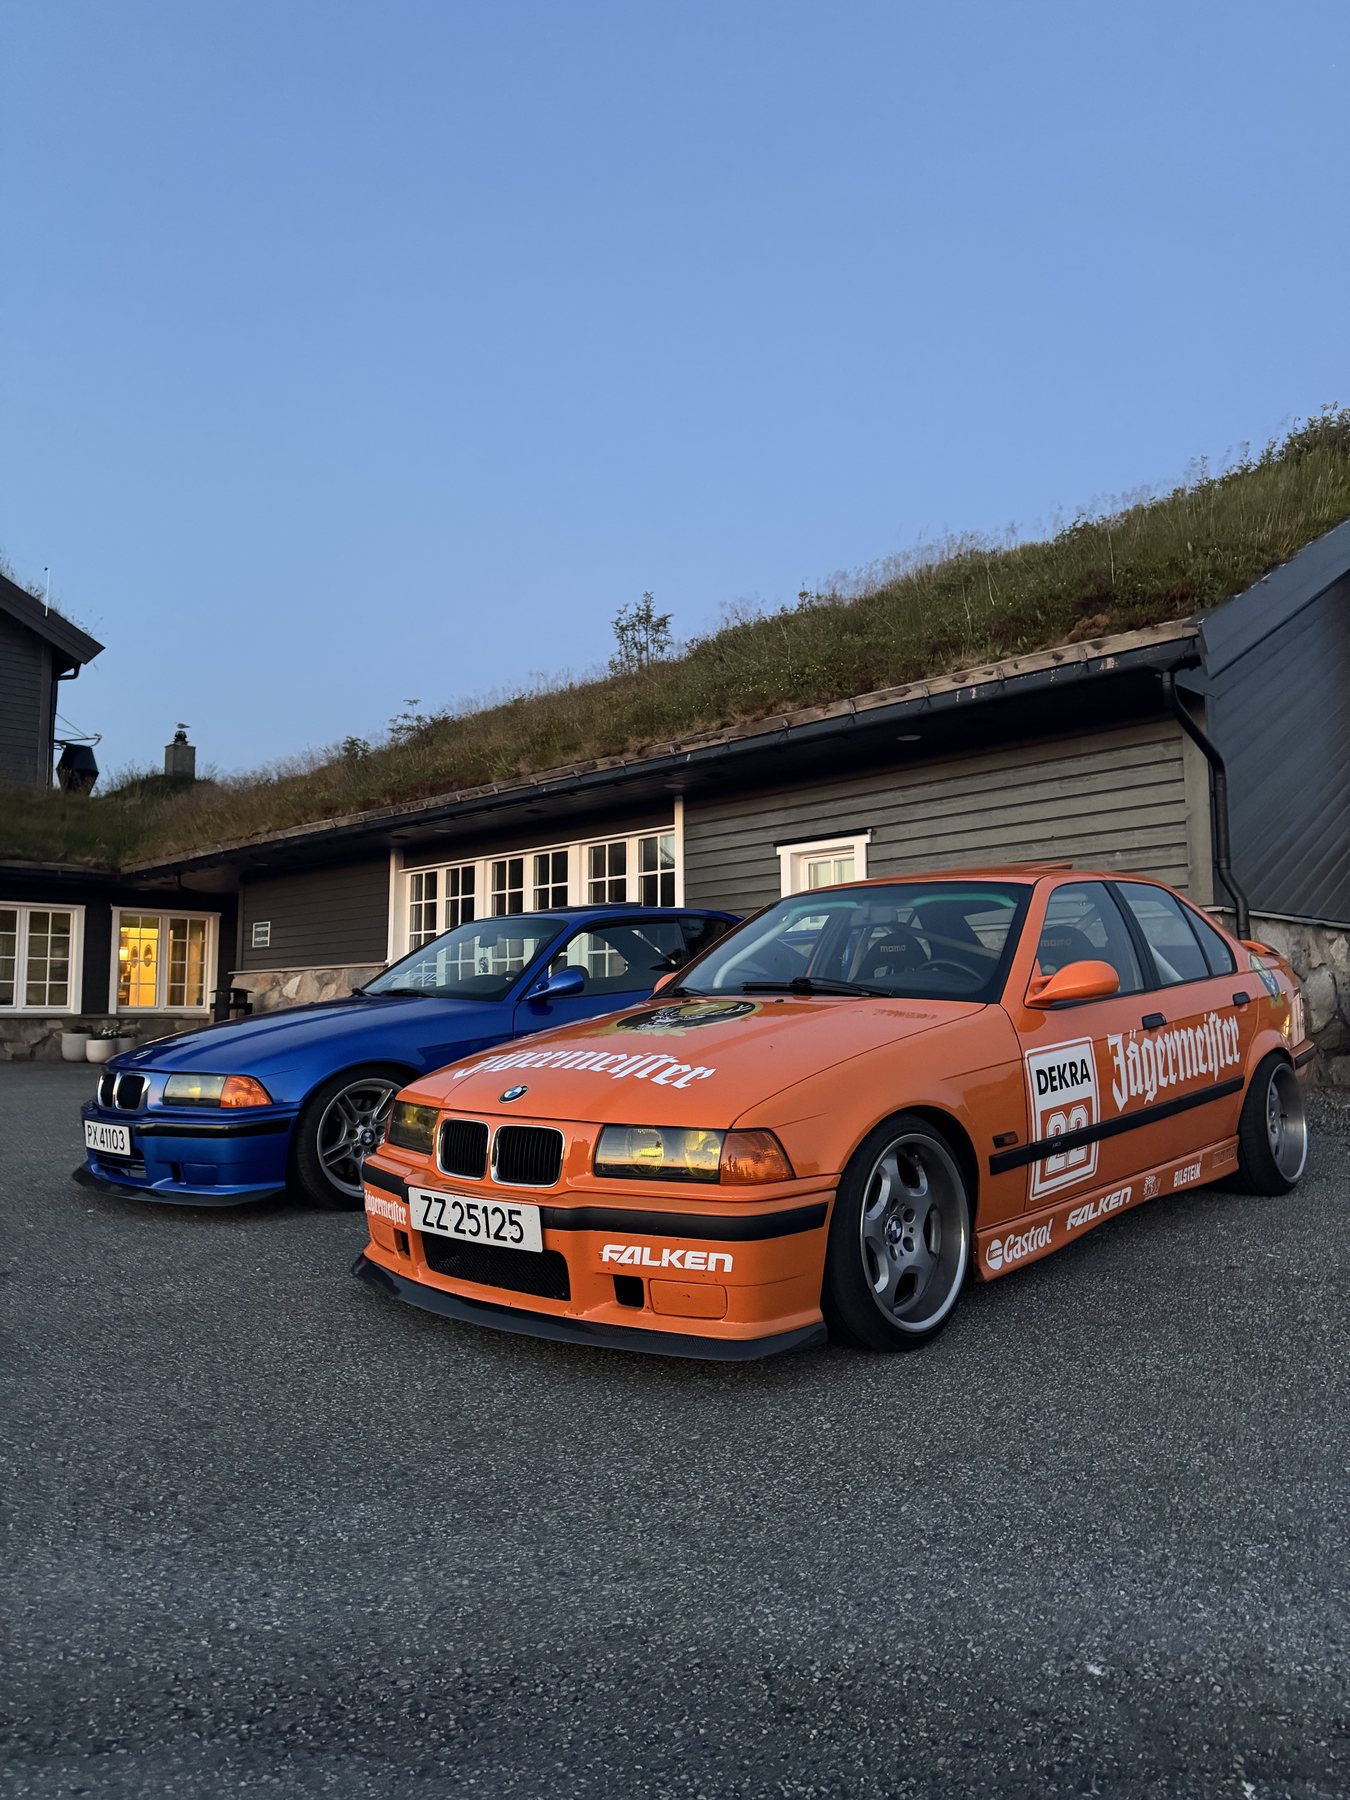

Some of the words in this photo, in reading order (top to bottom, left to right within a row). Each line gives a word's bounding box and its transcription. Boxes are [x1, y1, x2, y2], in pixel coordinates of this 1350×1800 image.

[880, 944, 906, 953] momo
[1036, 1058, 1091, 1096] DEKRA
[1107, 1011, 1241, 1113] Jägermeister
[87, 1124, 99, 1147] PX
[100, 1127, 125, 1151] 41103
[1045, 1104, 1088, 1176] 22
[1173, 1162, 1202, 1188] BILSTEIN
[420, 1194, 449, 1232] ZZ
[451, 1200, 525, 1244] 25125
[1066, 1186, 1132, 1232] FALKEN
[599, 1244, 733, 1273] FALKEN
[1003, 1218, 1054, 1264] Castrol
